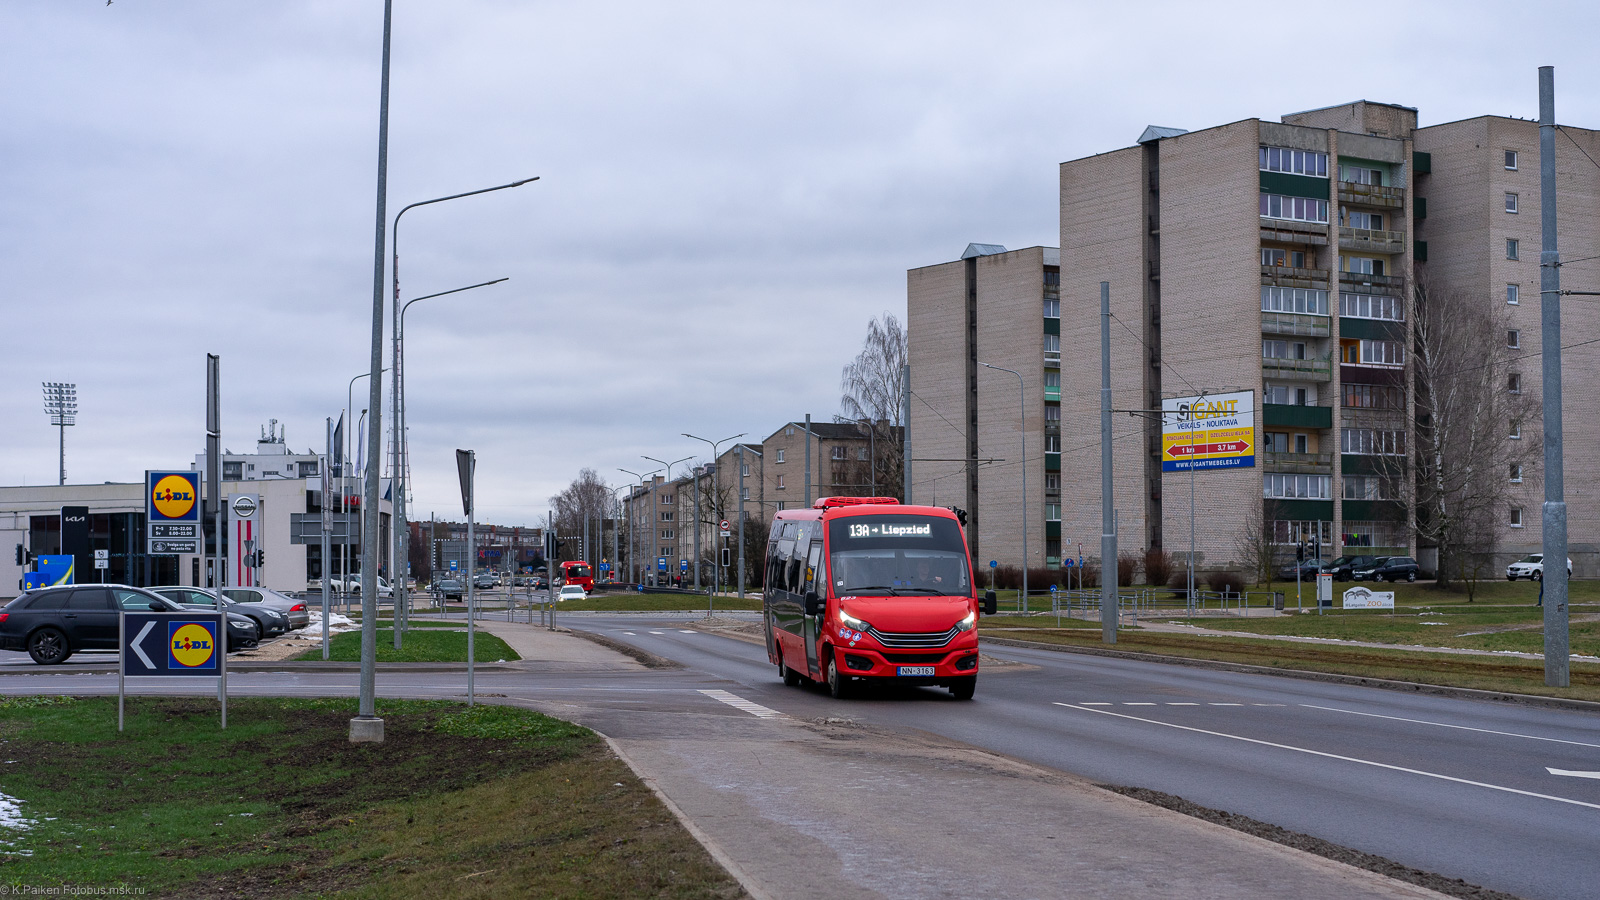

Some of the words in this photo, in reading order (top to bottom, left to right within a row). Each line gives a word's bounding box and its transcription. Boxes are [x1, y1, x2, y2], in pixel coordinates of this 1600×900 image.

[1177, 400, 1238, 420] GIGANT
[1177, 421, 1201, 430] VEIKALS
[1206, 418, 1238, 428] NOLIKTAVA
[155, 488, 192, 502] LIDL
[850, 524, 870, 536] 13A
[882, 524, 930, 536] Liepzied
[174, 637, 211, 651] LIDL
